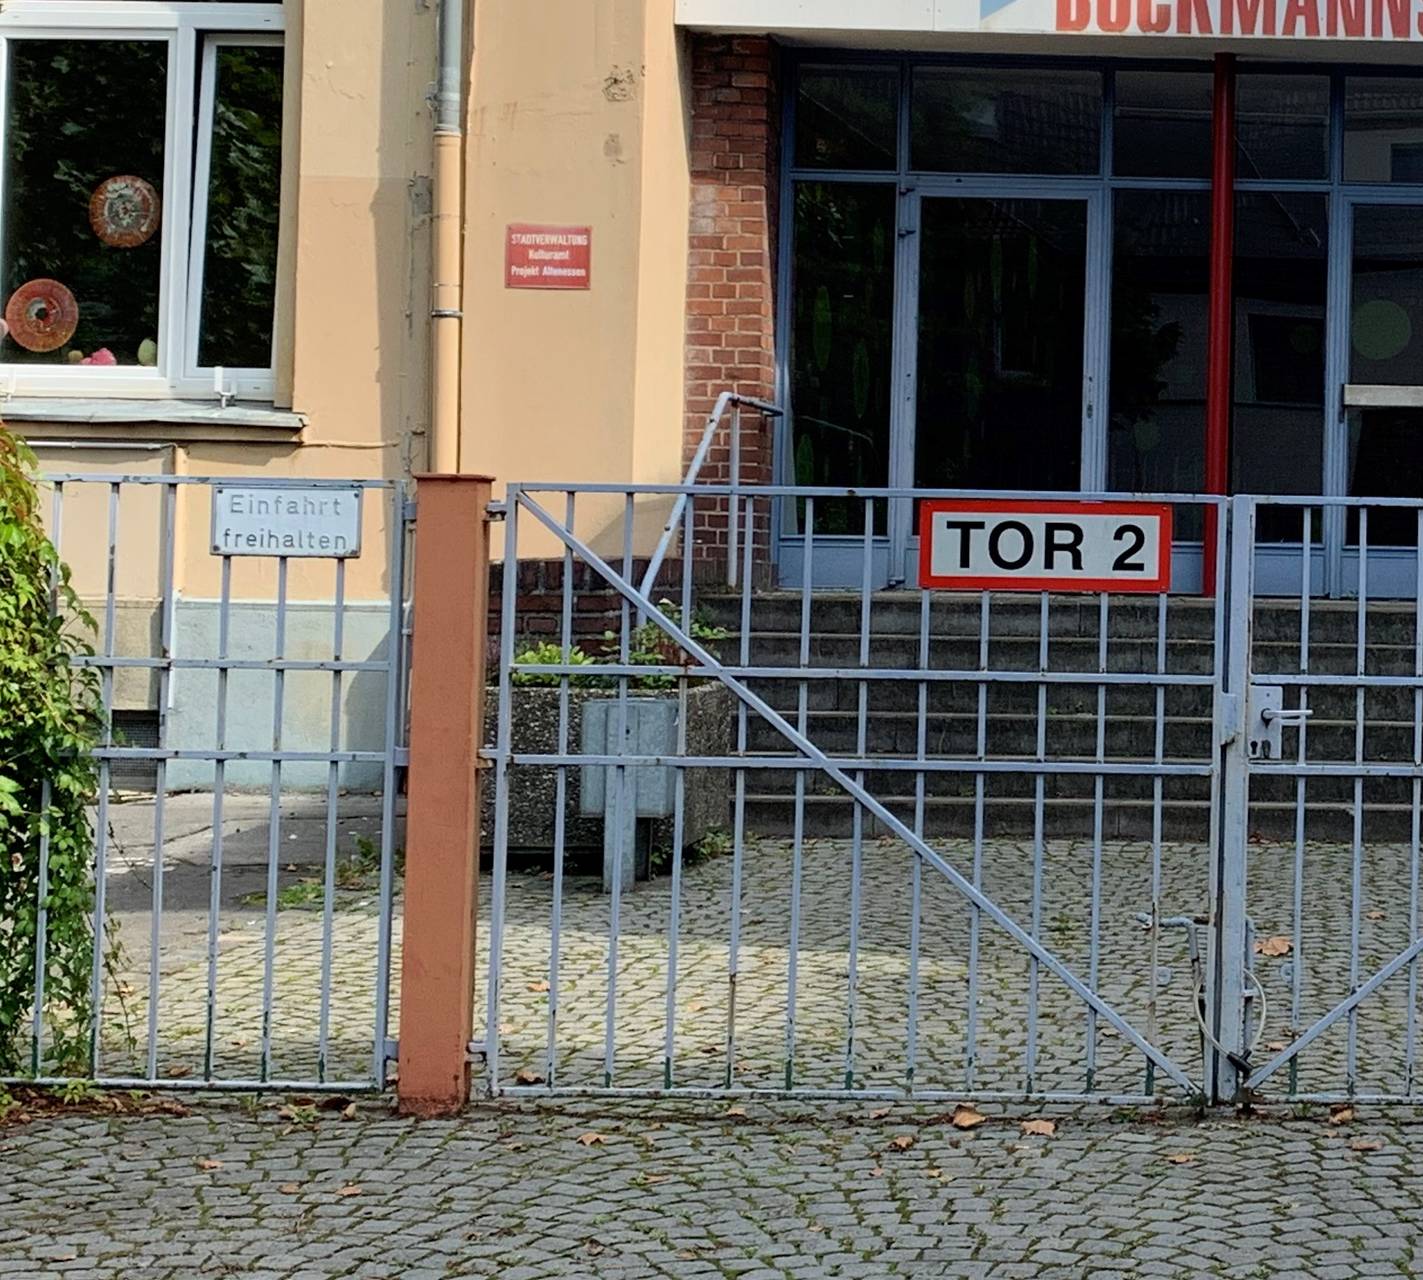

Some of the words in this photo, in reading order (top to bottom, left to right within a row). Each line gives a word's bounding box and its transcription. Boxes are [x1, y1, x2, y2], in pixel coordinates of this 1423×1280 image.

[511, 233, 588, 246] STADTVERWALTUNG
[528, 249, 570, 260] Kulturamt
[511, 265, 540, 278] Projekt
[229, 494, 342, 516] Einfahrt
[223, 528, 347, 550] freihalten
[946, 520, 1084, 570] TOR
[1112, 524, 1145, 571] 2
